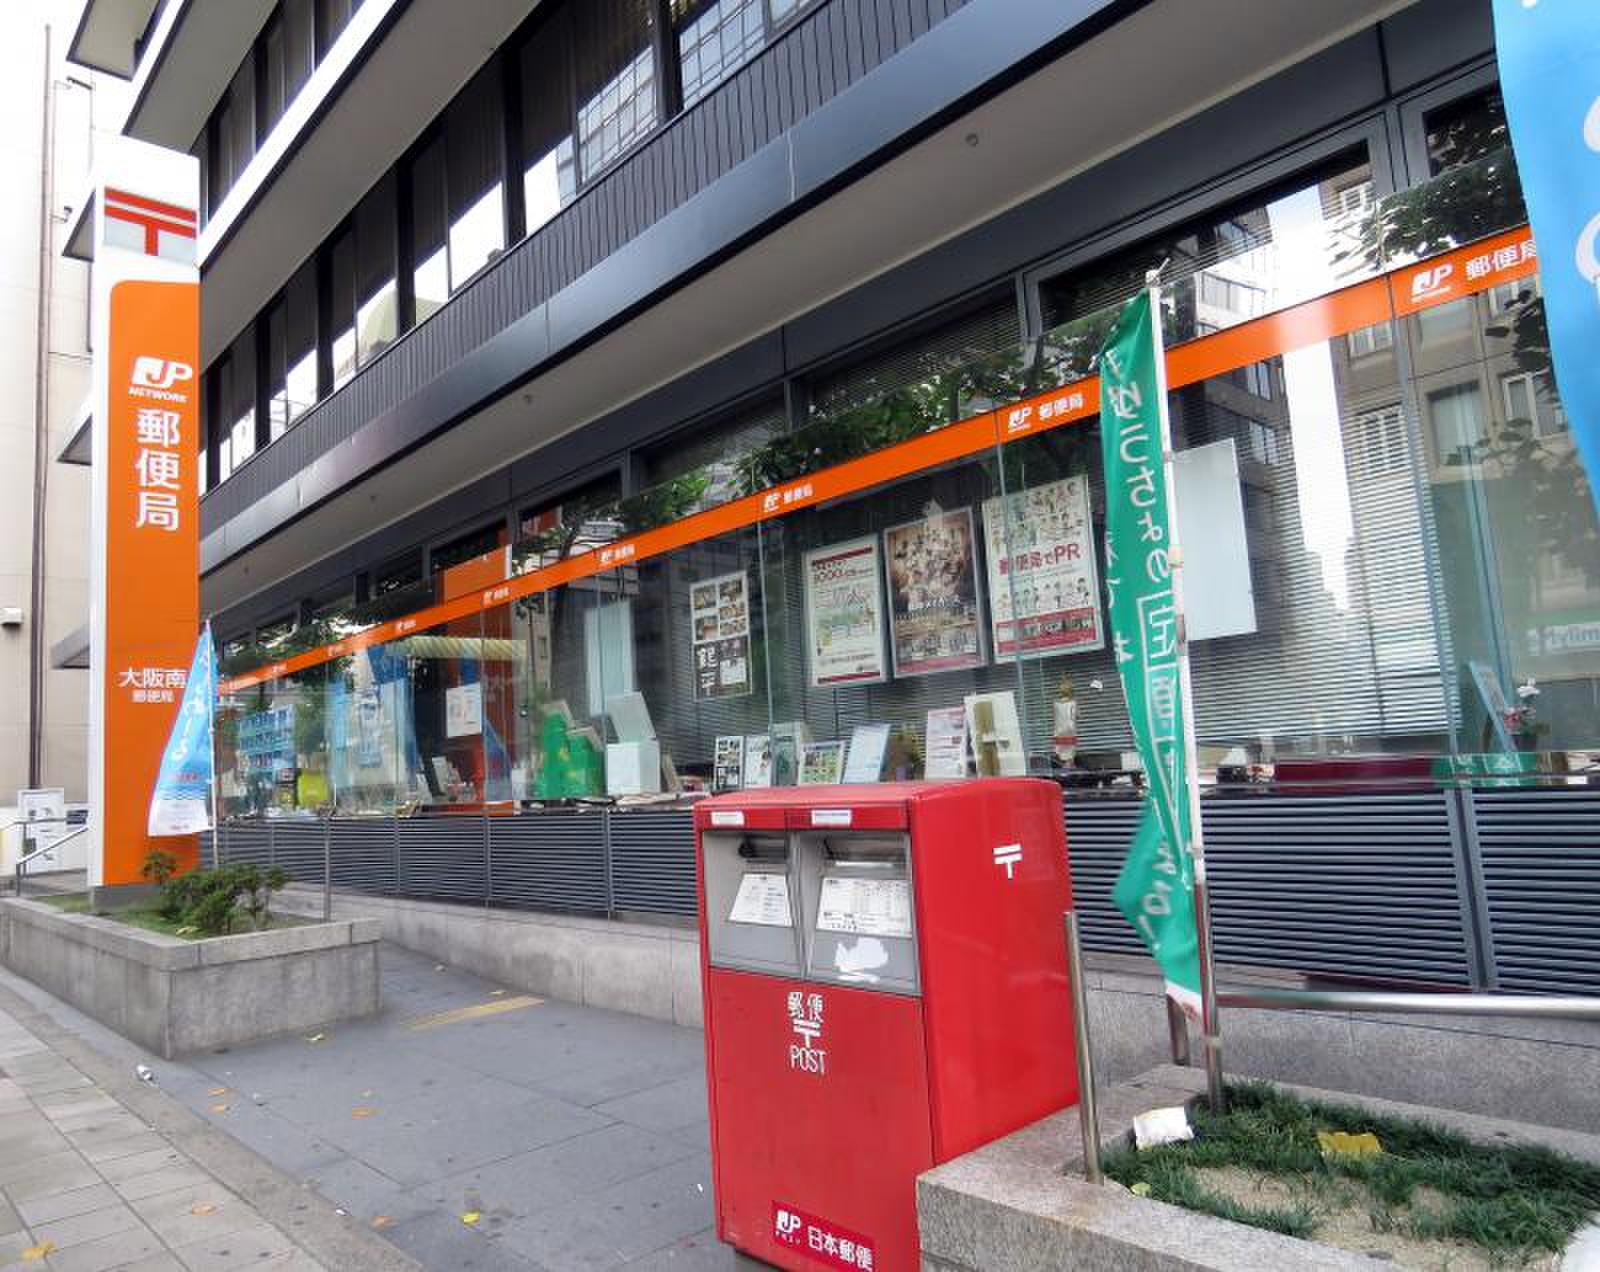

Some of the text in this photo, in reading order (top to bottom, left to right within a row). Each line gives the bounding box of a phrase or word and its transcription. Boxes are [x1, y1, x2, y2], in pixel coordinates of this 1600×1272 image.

[132, 356, 193, 389] JP
[135, 407, 181, 533] 郵便局
[118, 666, 187, 688] 大阪南
[788, 992, 823, 1024] 郵便
[790, 1045, 826, 1075] POST
[807, 1225, 873, 1272] 日本郵便
